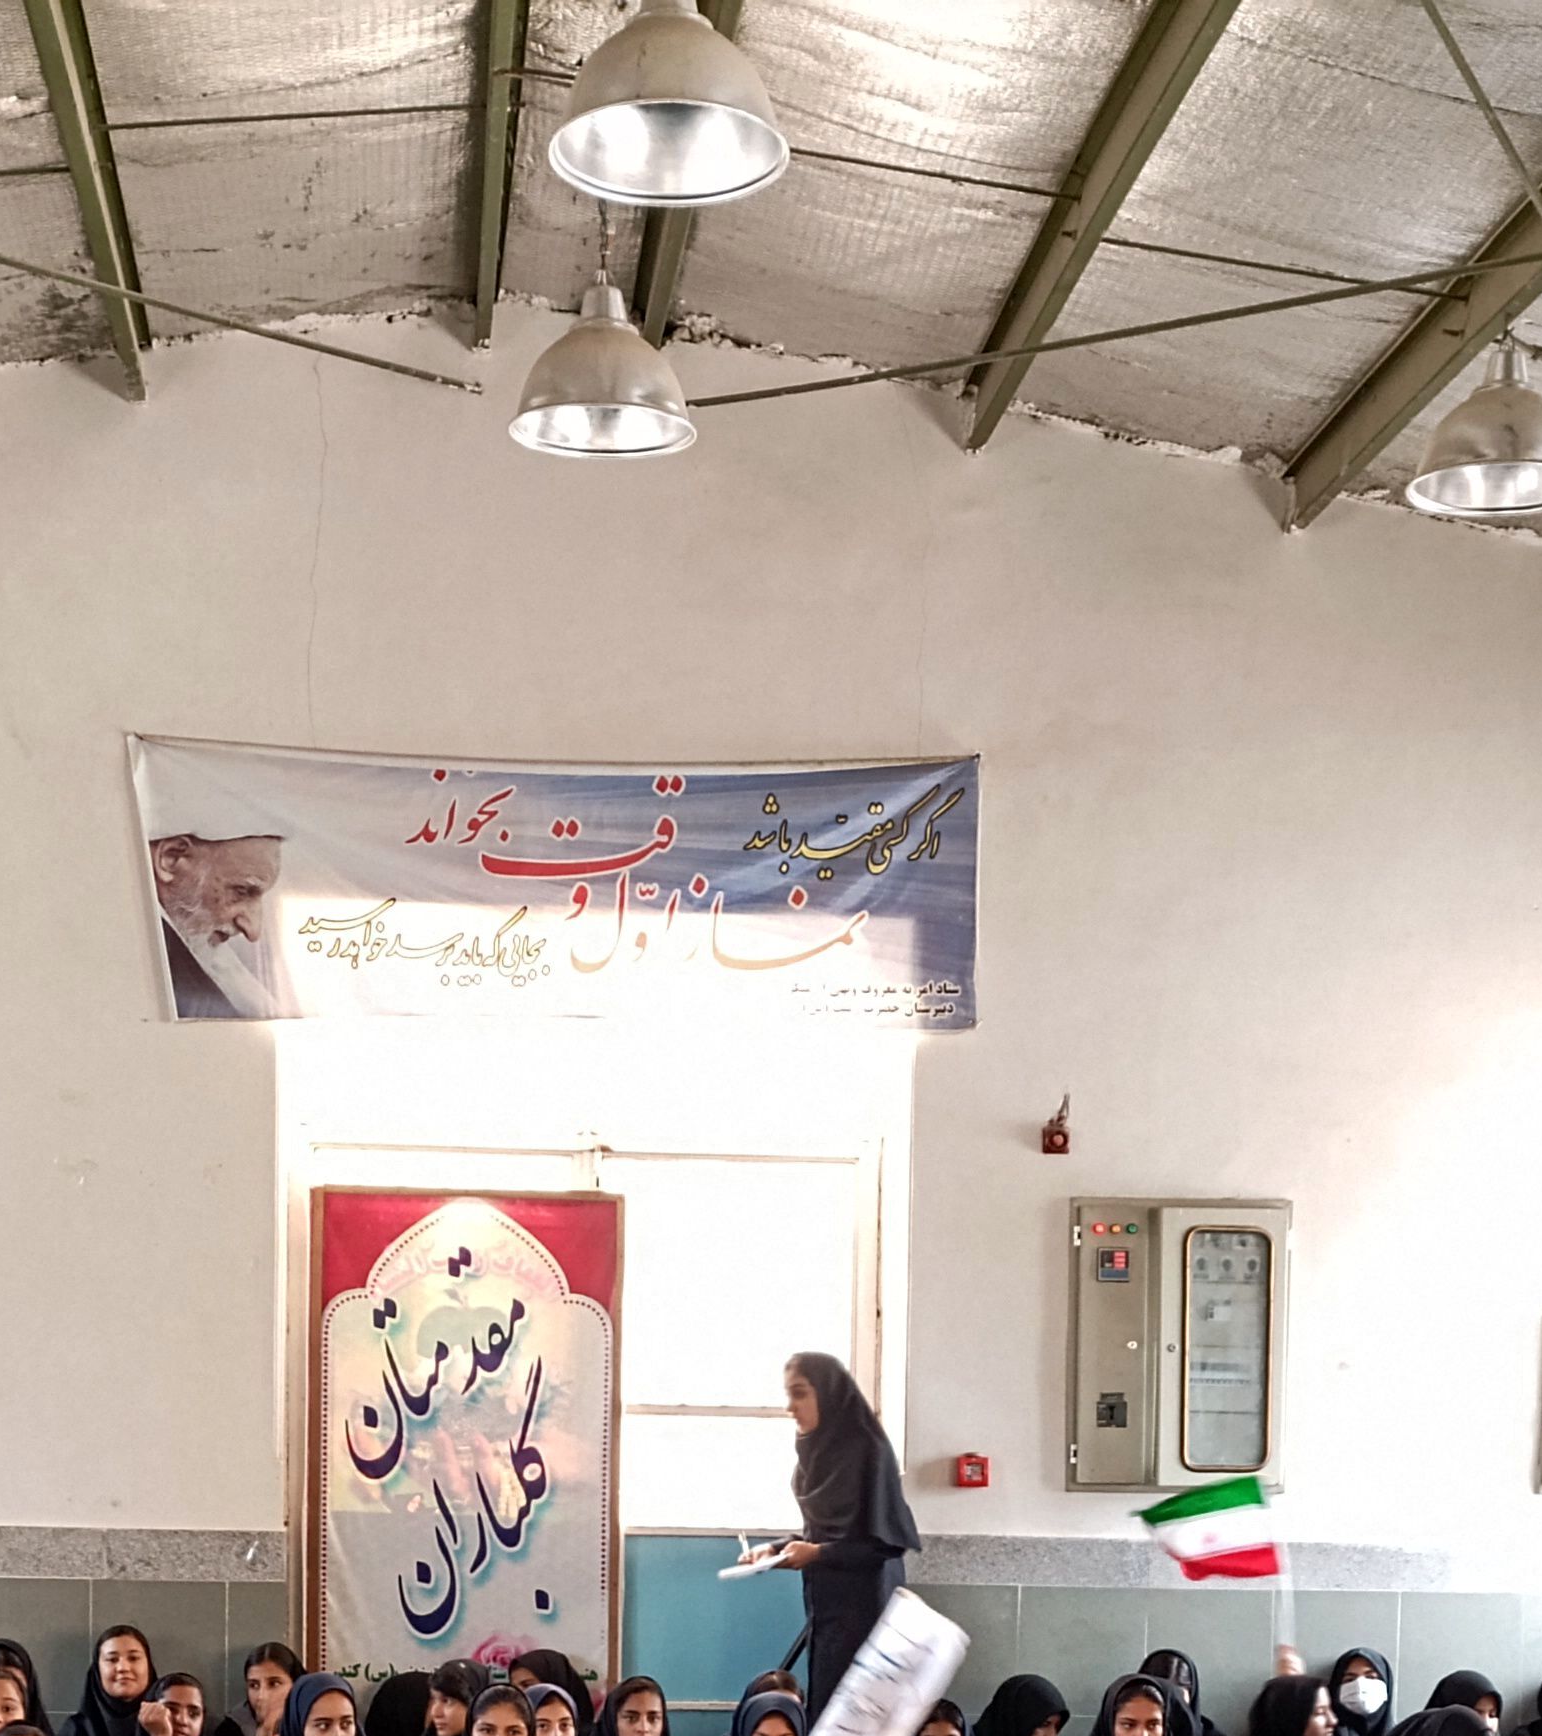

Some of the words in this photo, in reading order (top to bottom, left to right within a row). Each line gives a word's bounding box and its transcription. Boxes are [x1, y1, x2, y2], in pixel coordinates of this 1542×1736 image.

[743, 792, 792, 875] باشد
[866, 784, 941, 875] کسی
[908, 787, 965, 861] اگر
